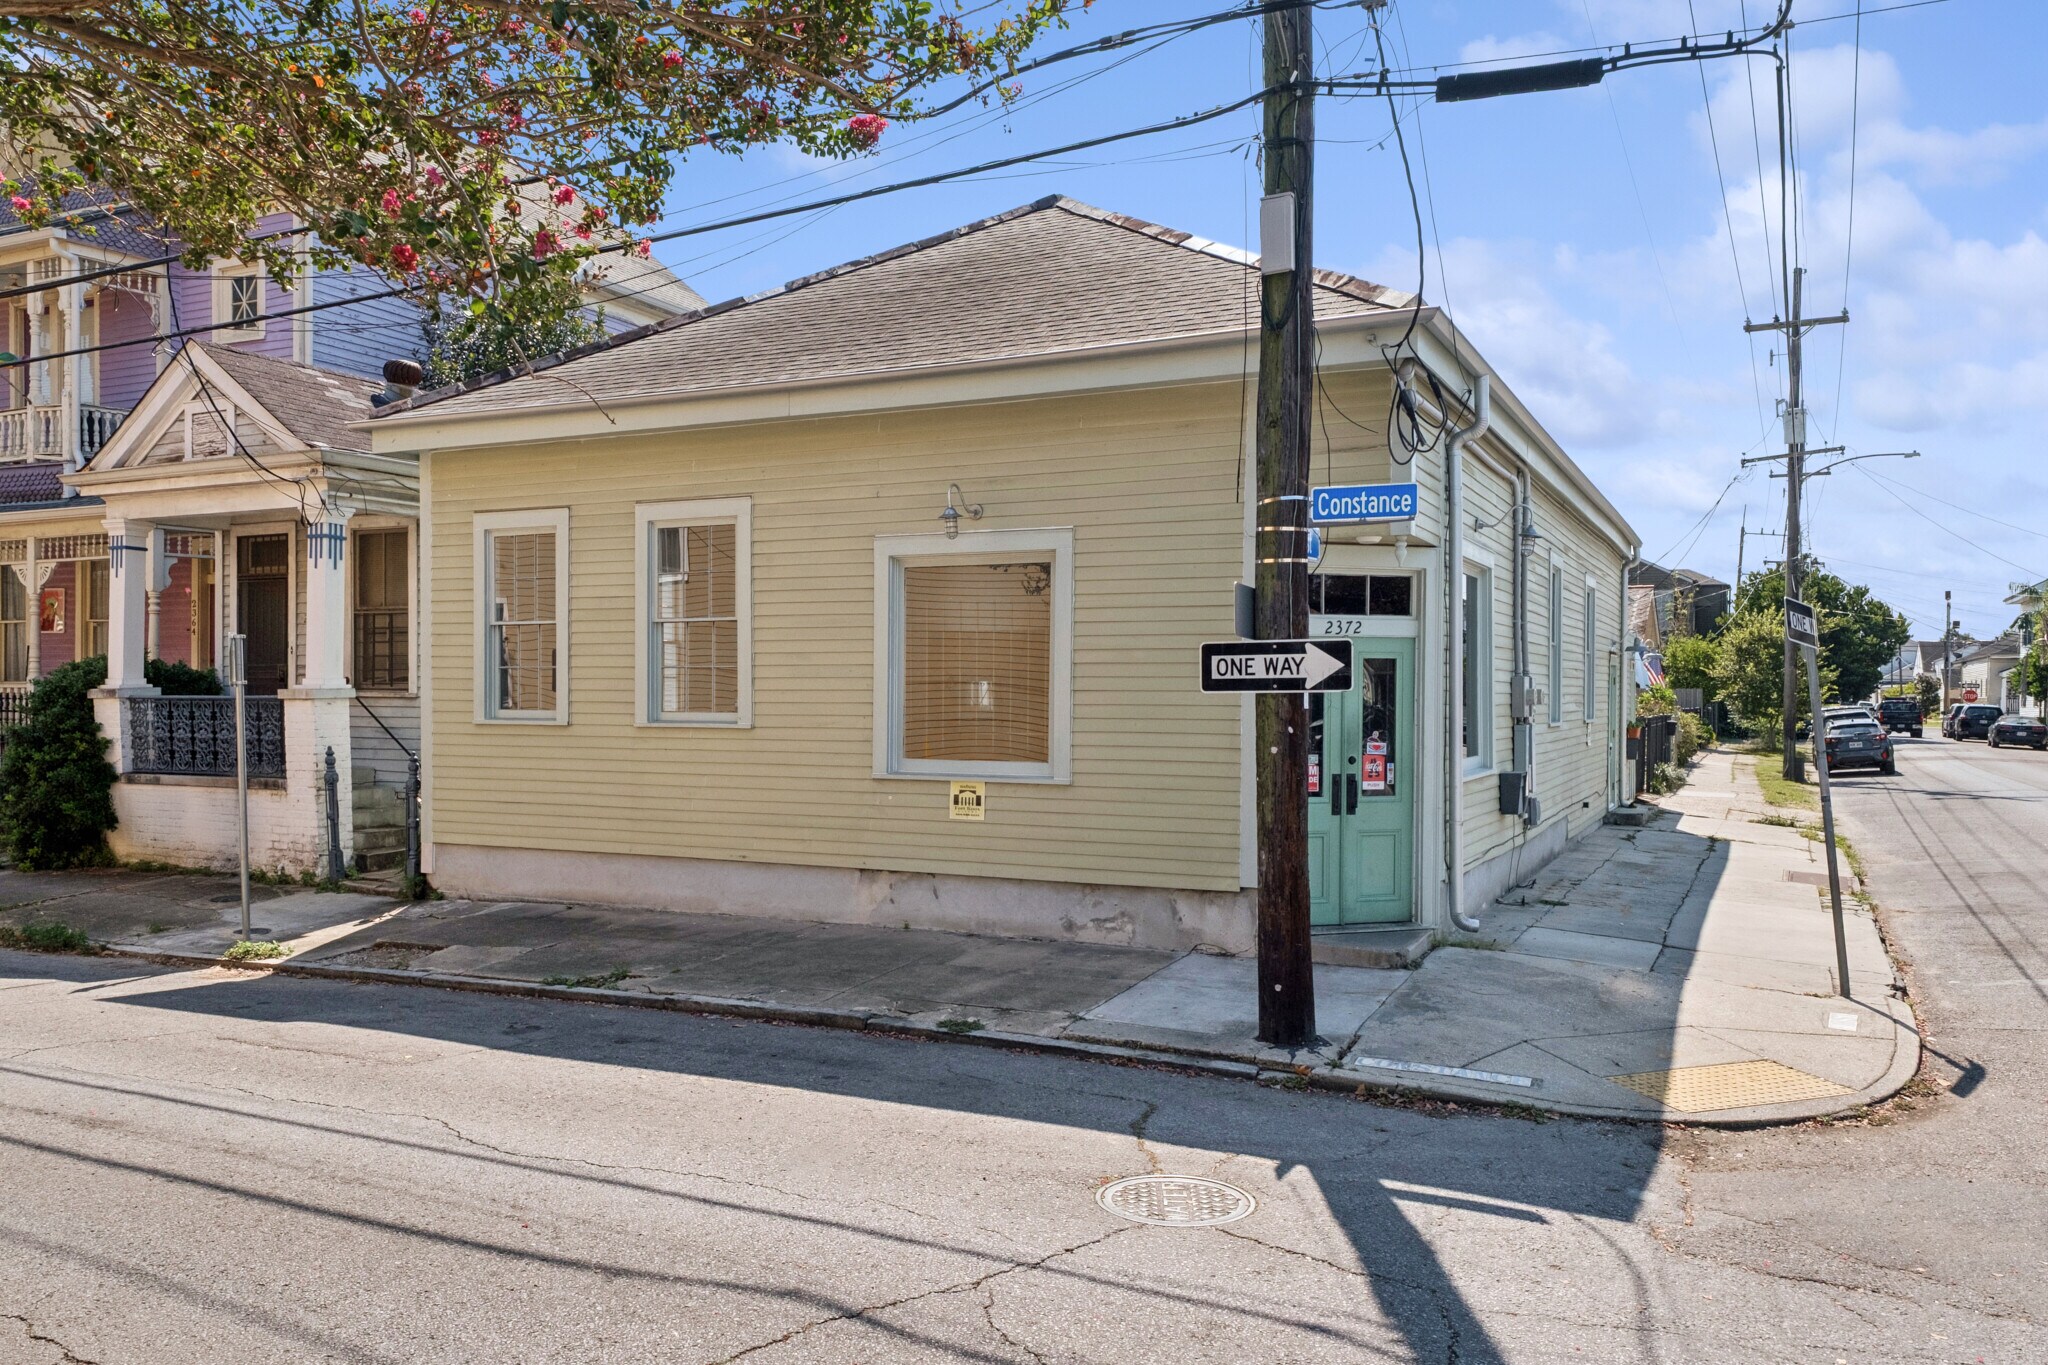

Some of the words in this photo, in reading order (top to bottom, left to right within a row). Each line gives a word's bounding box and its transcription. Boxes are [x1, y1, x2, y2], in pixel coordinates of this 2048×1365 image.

[1318, 491, 1412, 516] Constance
[1324, 620, 1363, 635] 2372
[1791, 612, 1807, 632] ONE
[1216, 657, 1256, 677] ONE
[1263, 656, 1306, 676] WAY
